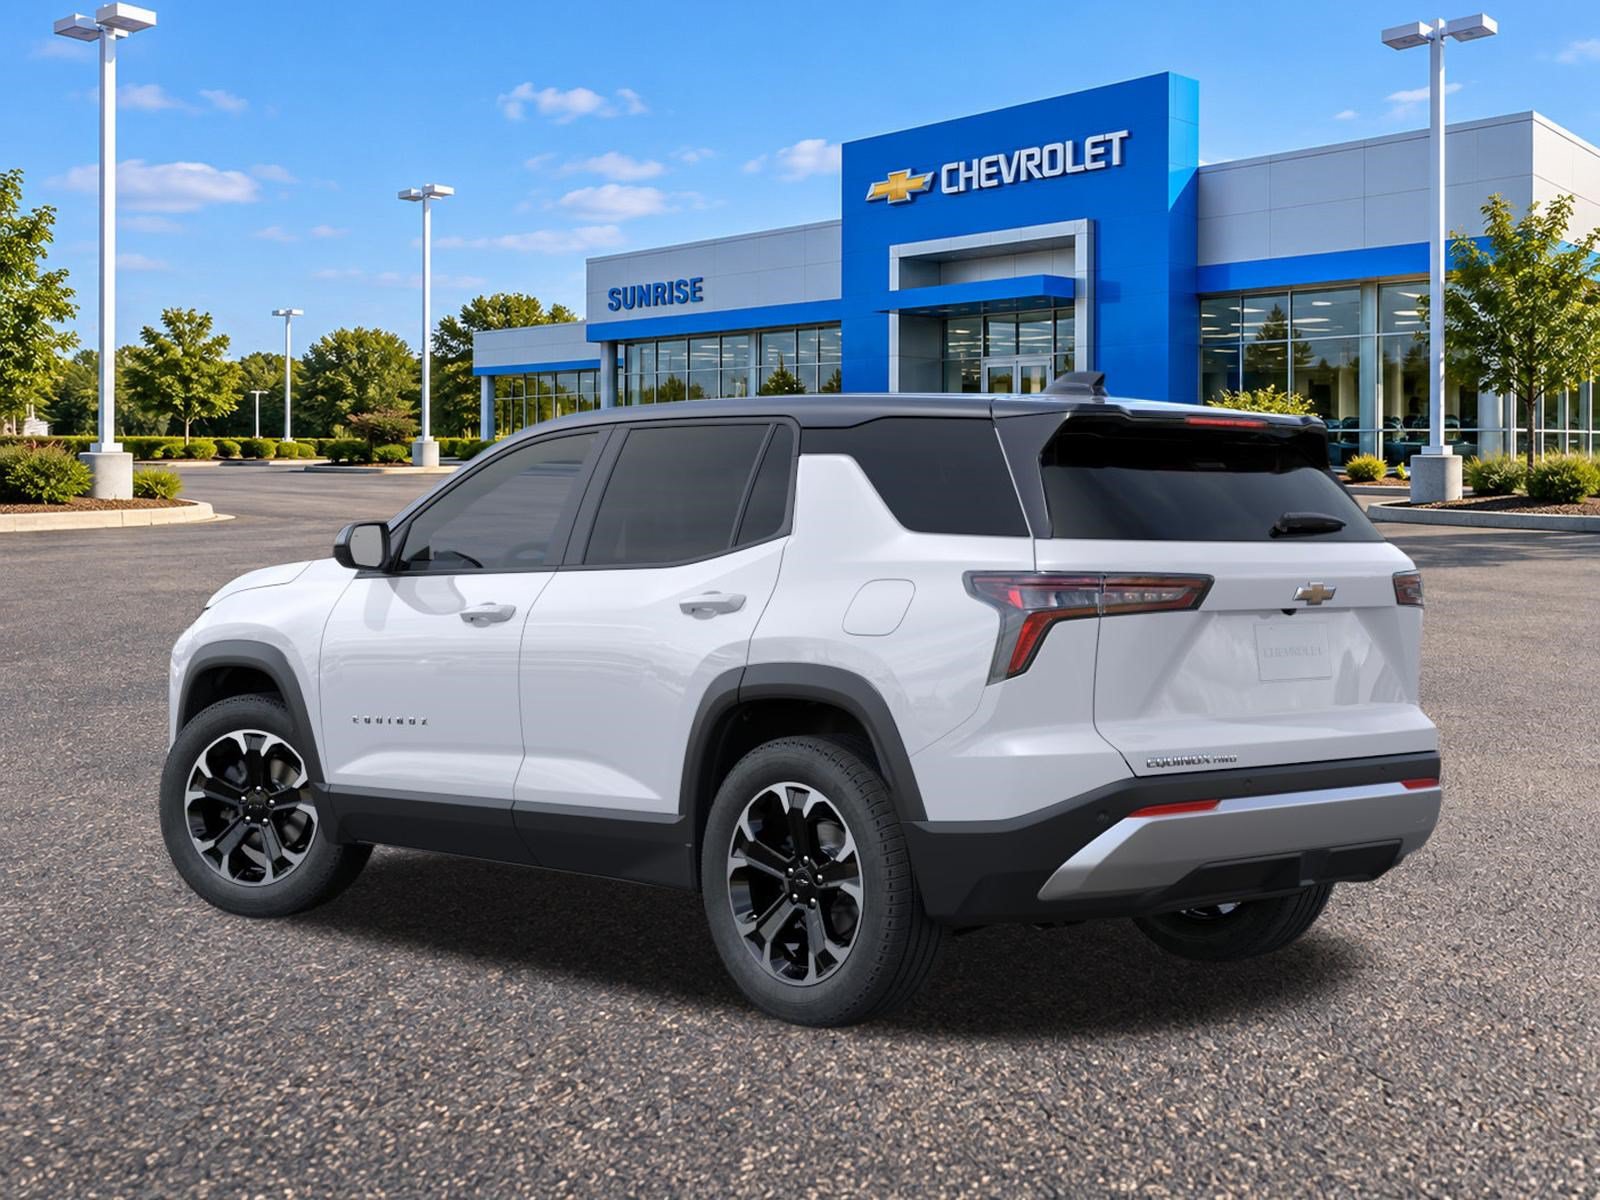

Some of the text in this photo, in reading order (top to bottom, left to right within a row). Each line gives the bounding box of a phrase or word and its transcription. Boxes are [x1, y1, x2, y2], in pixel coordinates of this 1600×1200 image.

[941, 130, 1129, 194] CHEVROLET
[608, 277, 704, 312] SUNRISE
[1146, 755, 1211, 769] EQUINOX
